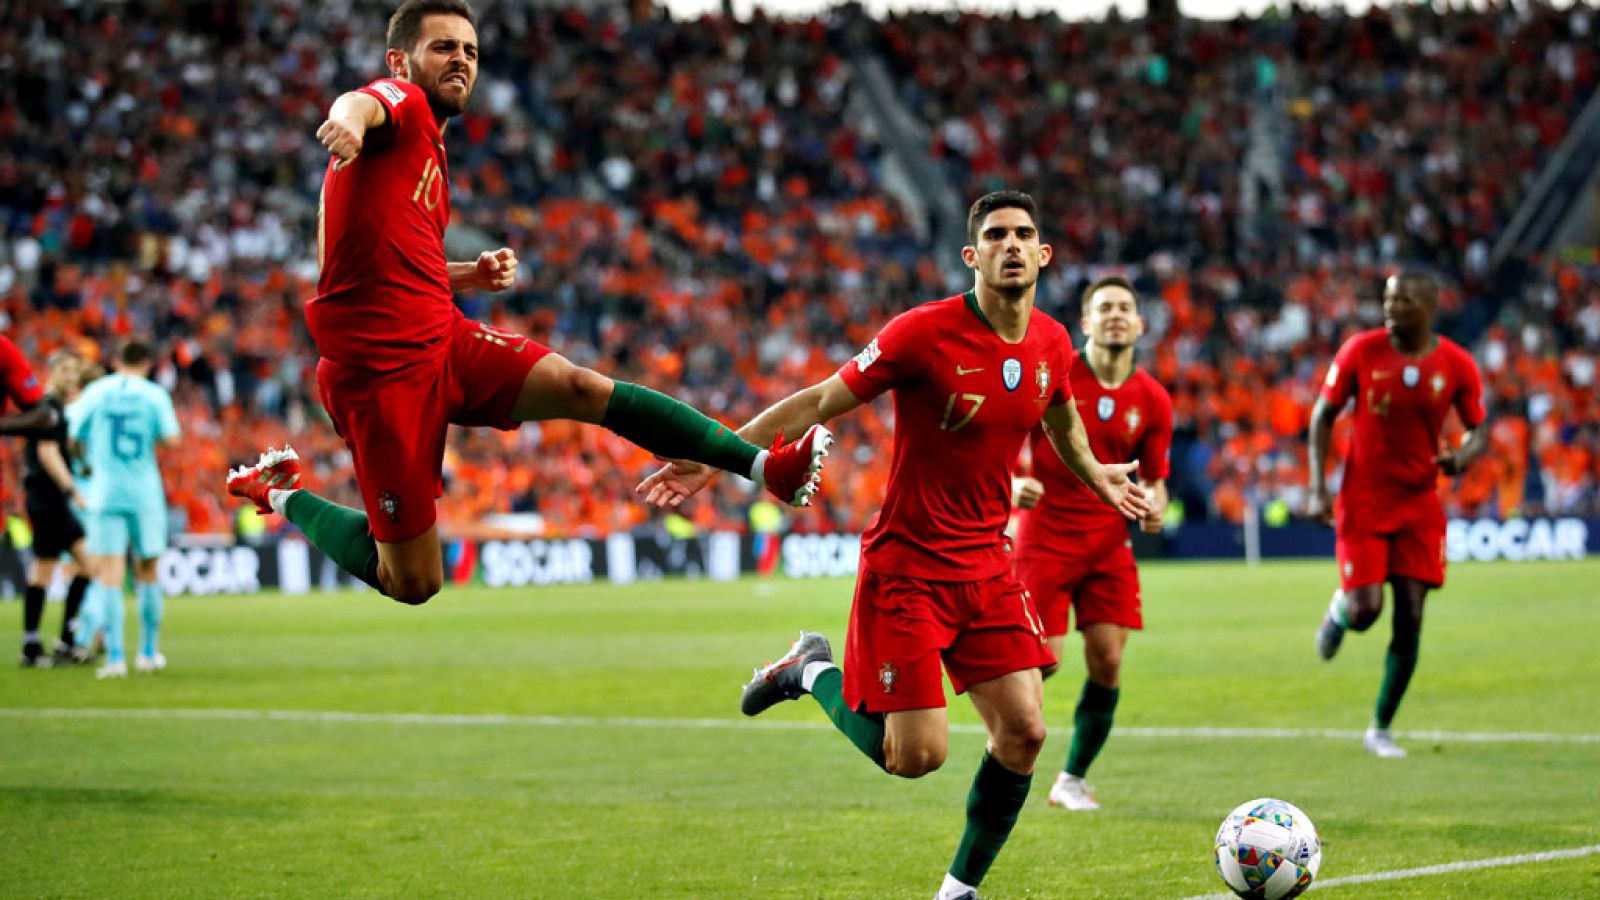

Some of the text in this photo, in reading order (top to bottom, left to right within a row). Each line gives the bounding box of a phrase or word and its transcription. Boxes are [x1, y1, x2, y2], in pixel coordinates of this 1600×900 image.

[412, 157, 444, 212] 10
[940, 392, 986, 431] 17
[1367, 389, 1392, 418] 14
[104, 411, 144, 464] 15
[481, 539, 592, 587] SOCAR
[783, 533, 861, 577] SOCA
[1446, 519, 1587, 561] SOCAR
[157, 546, 261, 594] OCAR
